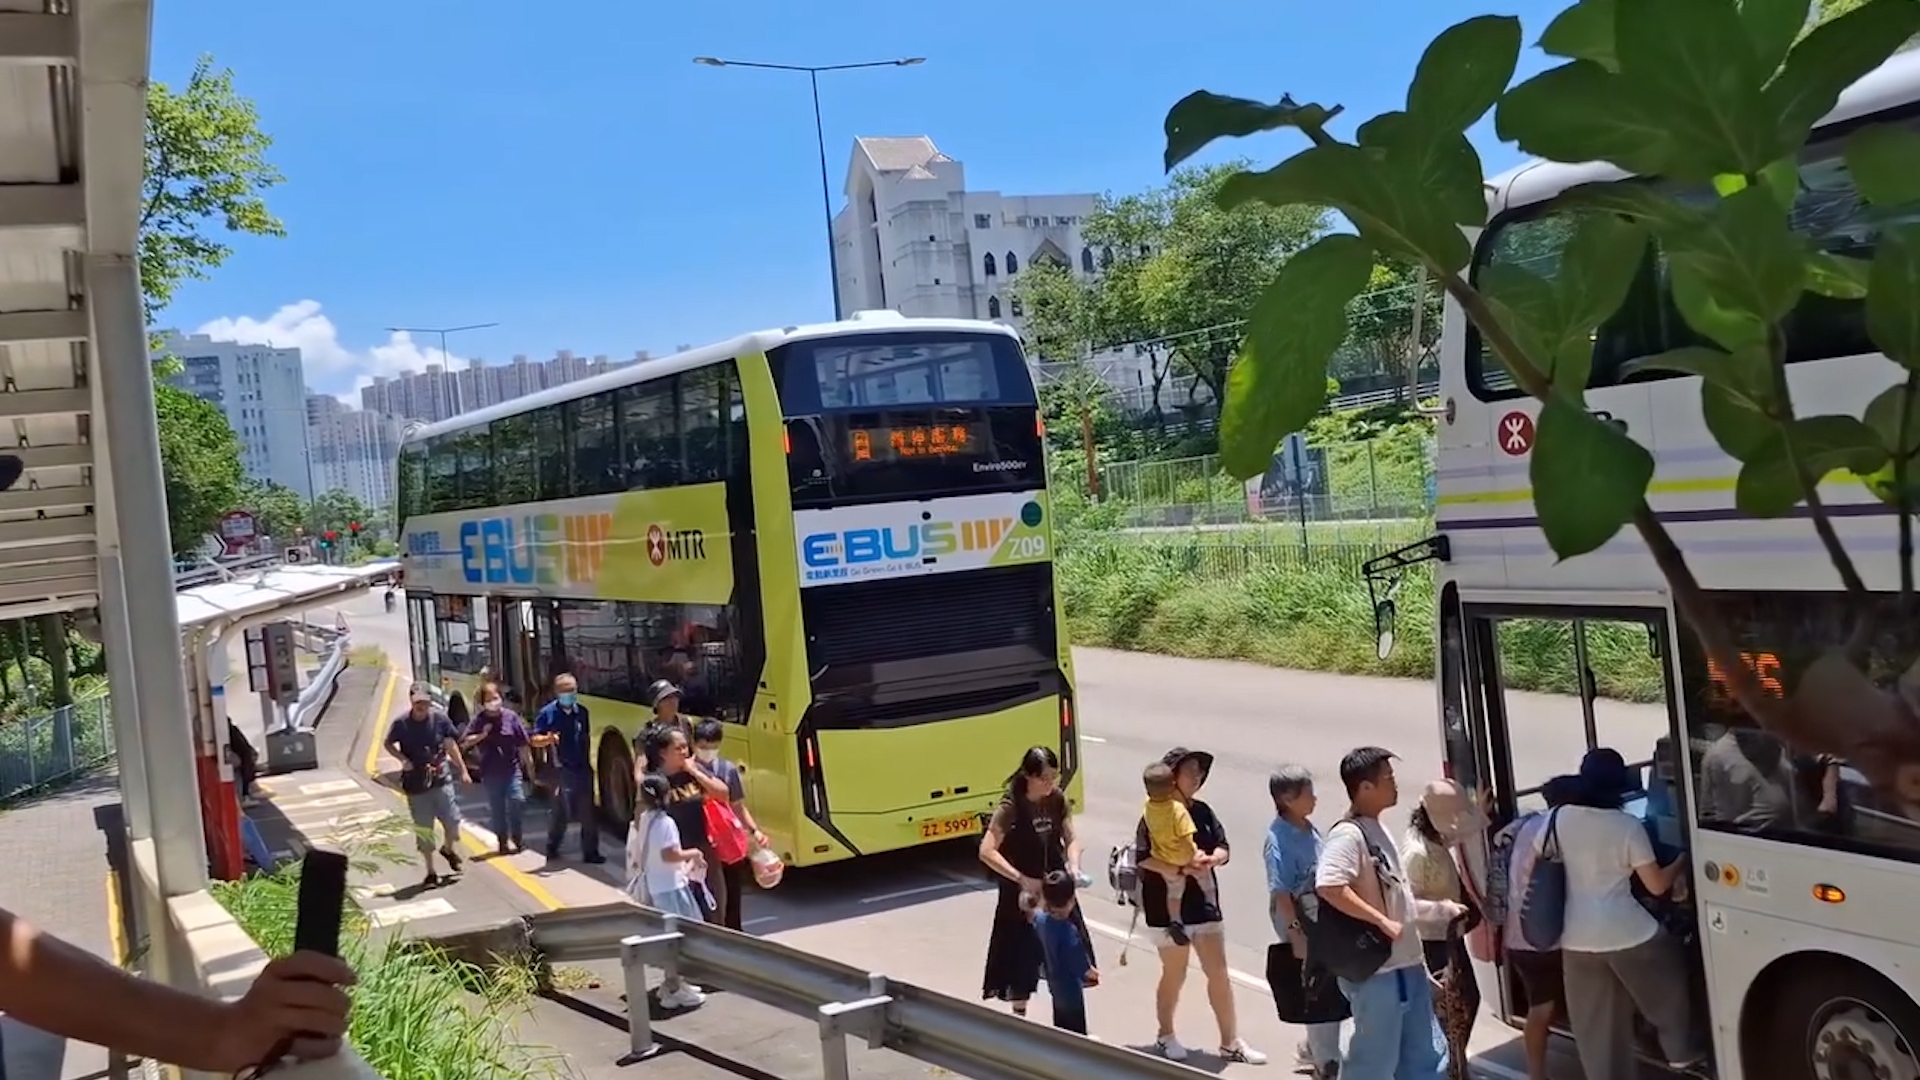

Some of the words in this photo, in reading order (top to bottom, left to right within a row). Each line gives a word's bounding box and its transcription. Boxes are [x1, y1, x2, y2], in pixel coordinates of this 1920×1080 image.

[460, 514, 559, 583] EBUS
[667, 529, 706, 559] MTR
[803, 520, 957, 568] EBUS
[1008, 535, 1045, 559] Z09
[922, 823, 939, 837] ZZ
